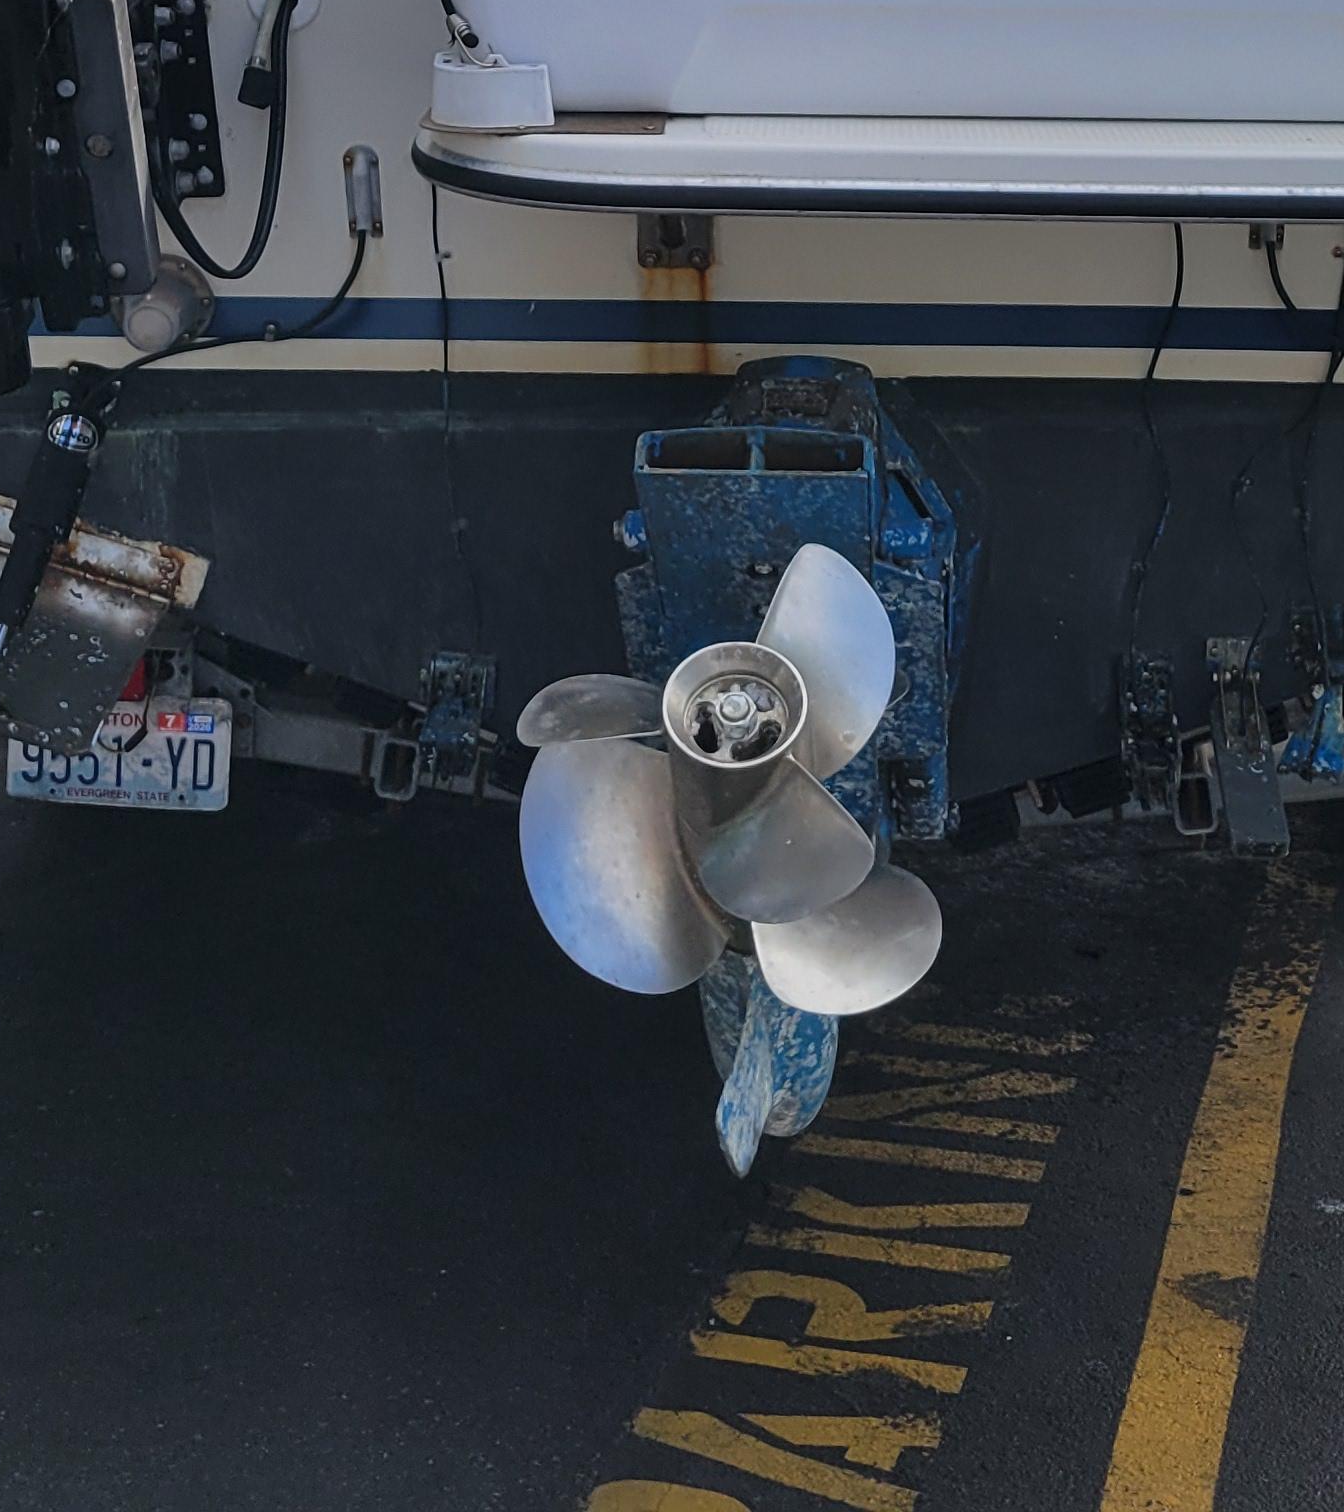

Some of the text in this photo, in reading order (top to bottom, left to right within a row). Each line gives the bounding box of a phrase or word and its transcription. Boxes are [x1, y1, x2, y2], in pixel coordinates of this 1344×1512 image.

[164, 713, 176, 728] 7
[67, 788, 170, 801] EVERGREEN STATE
